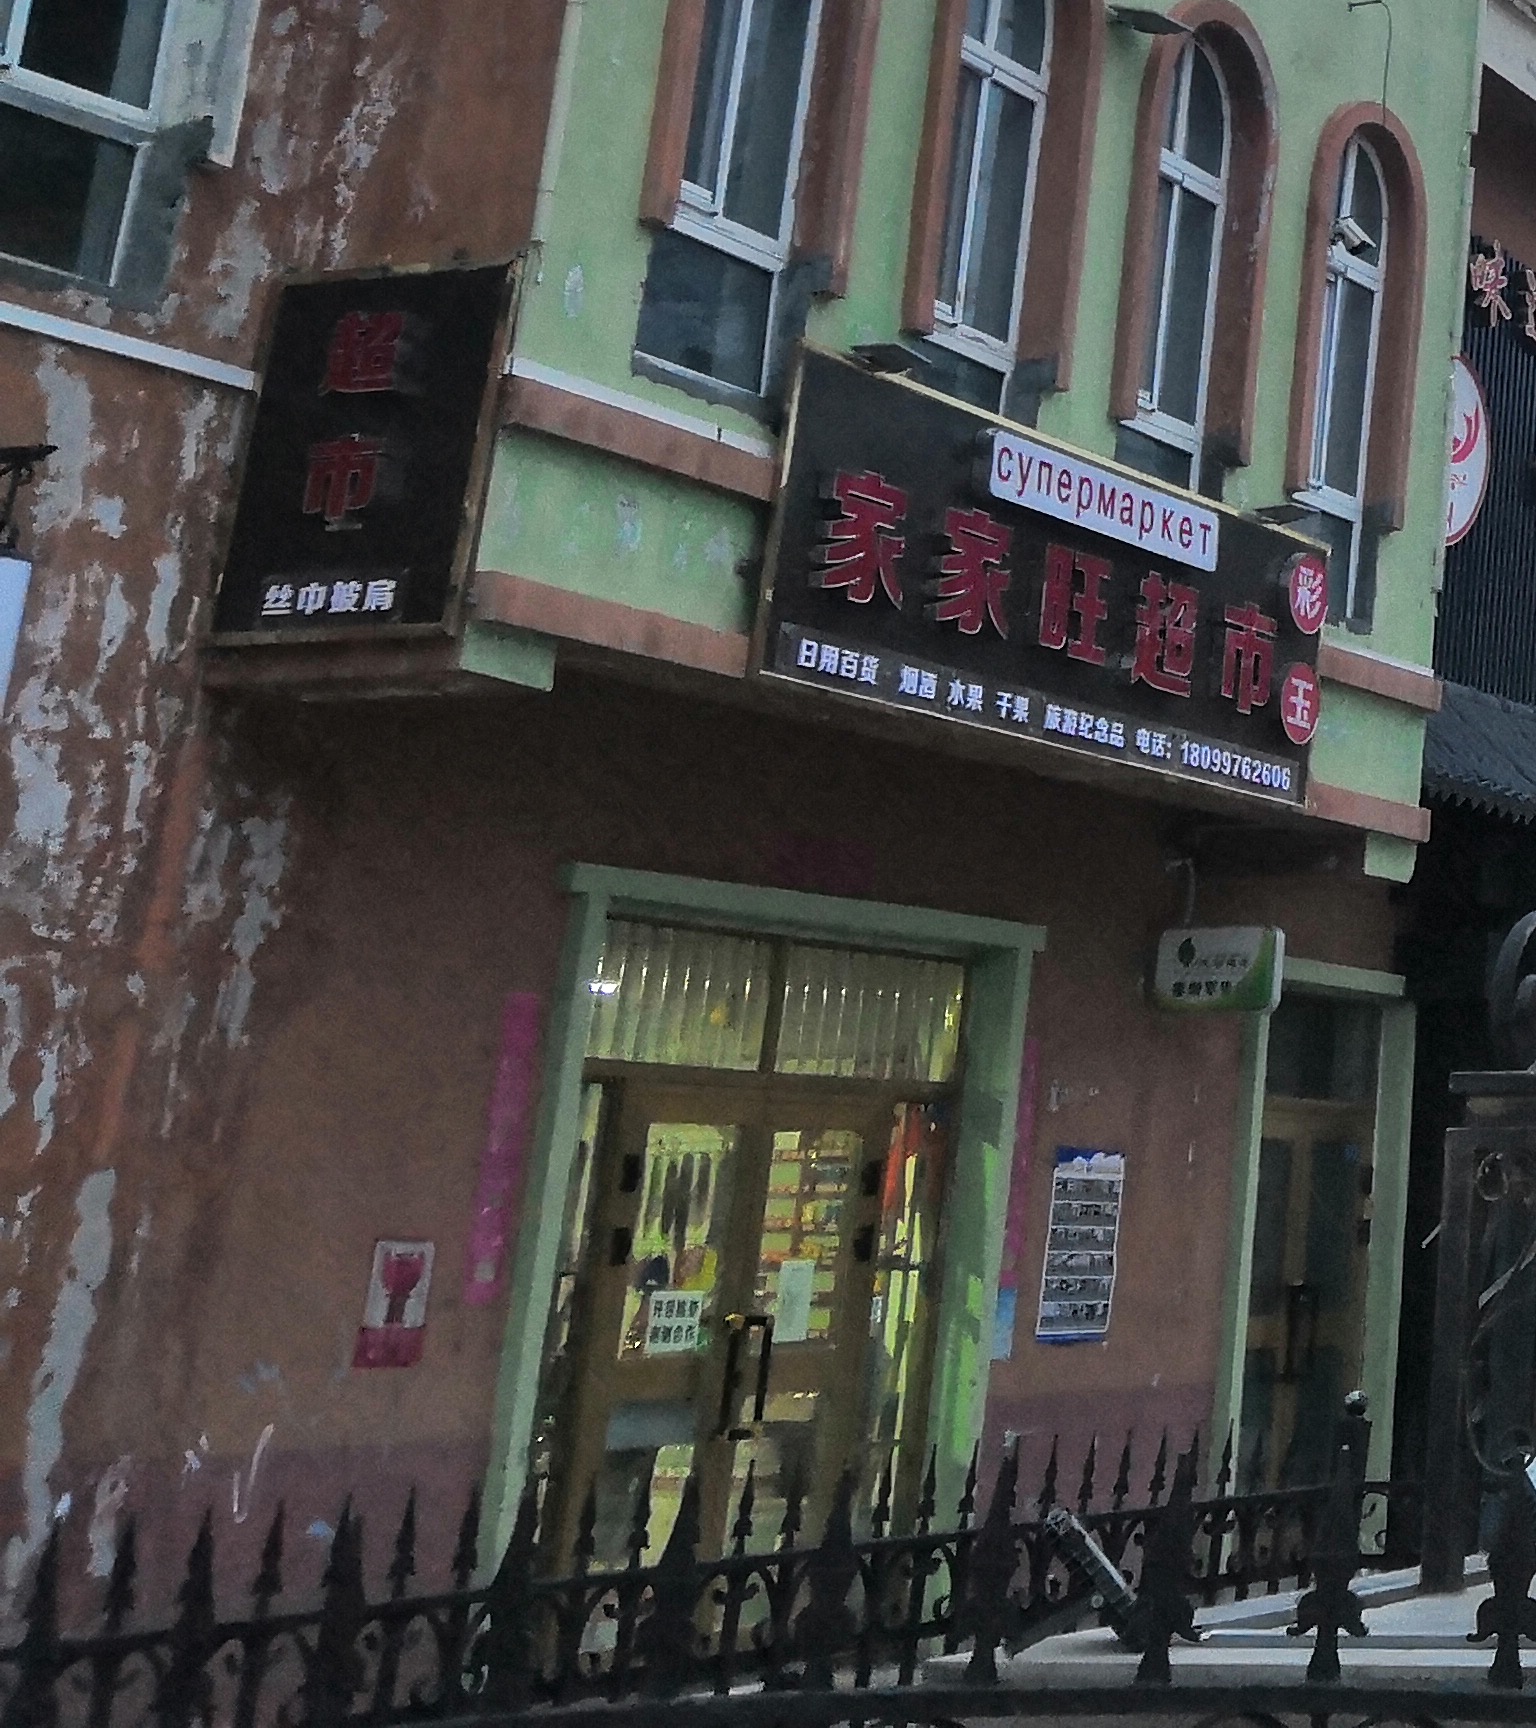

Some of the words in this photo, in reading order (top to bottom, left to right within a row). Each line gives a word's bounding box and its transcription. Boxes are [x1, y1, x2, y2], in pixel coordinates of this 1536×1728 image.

[303, 310, 406, 524] 超市
[996, 445, 1213, 556] супермаркет
[261, 577, 398, 617] 丝巾披肩
[820, 470, 1279, 715] 家家旺超市
[797, 638, 880, 686] 日用百货
[899, 663, 938, 700] 烟酒
[947, 678, 984, 713] 水果
[995, 690, 1030, 723] 干果
[1043, 703, 1126, 749] 旅游纪念品
[1180, 740, 1292, 791] 18099762606
